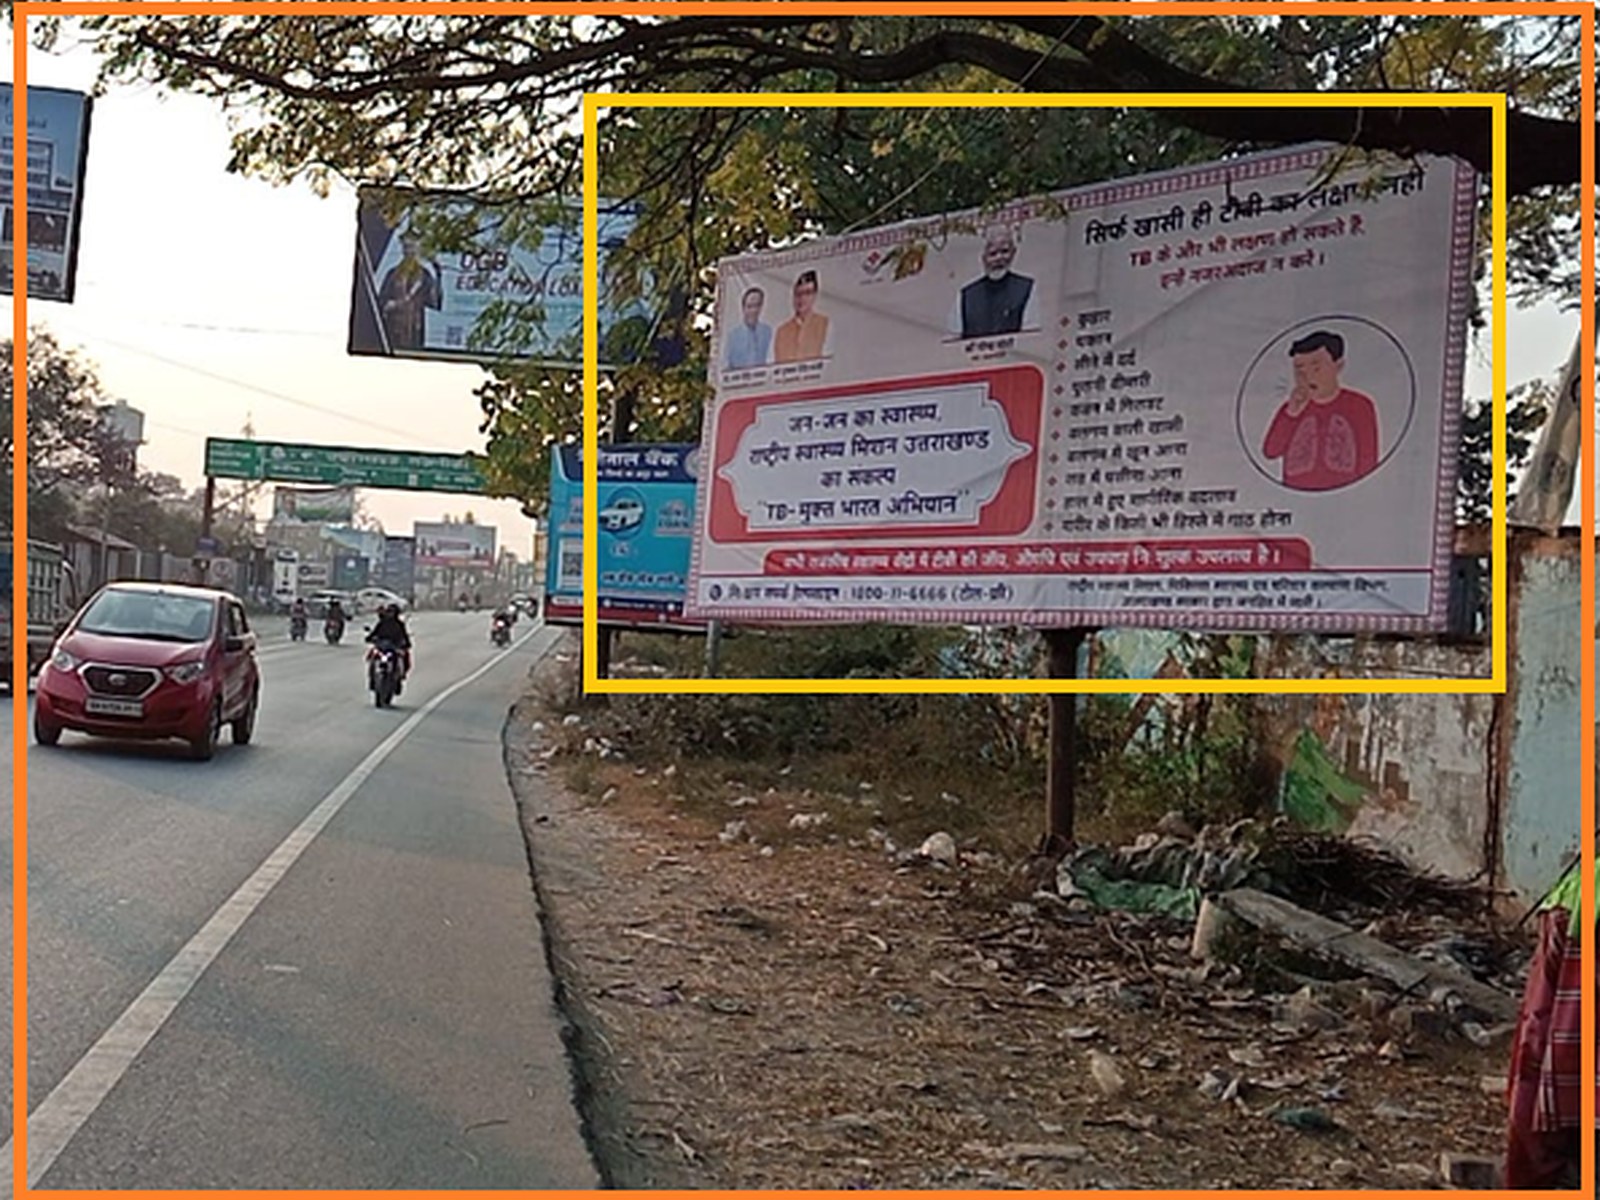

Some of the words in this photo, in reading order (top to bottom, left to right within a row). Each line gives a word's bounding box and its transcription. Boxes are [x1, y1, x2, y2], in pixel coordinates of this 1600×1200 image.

[1086, 214, 1127, 246] सिर्फ
[1191, 200, 1213, 230] ही
[1130, 250, 1152, 266] TB
[1176, 239, 1203, 260] और
[1232, 231, 1276, 250] लक्षण
[1280, 225, 1296, 245] हो
[1303, 217, 1346, 241] सकते
[853, 408, 875, 427] का
[851, 434, 898, 457] मिशन
[903, 429, 990, 454] उत्तराखण्ड
[820, 470, 842, 487] का
[840, 498, 881, 519] भारत
